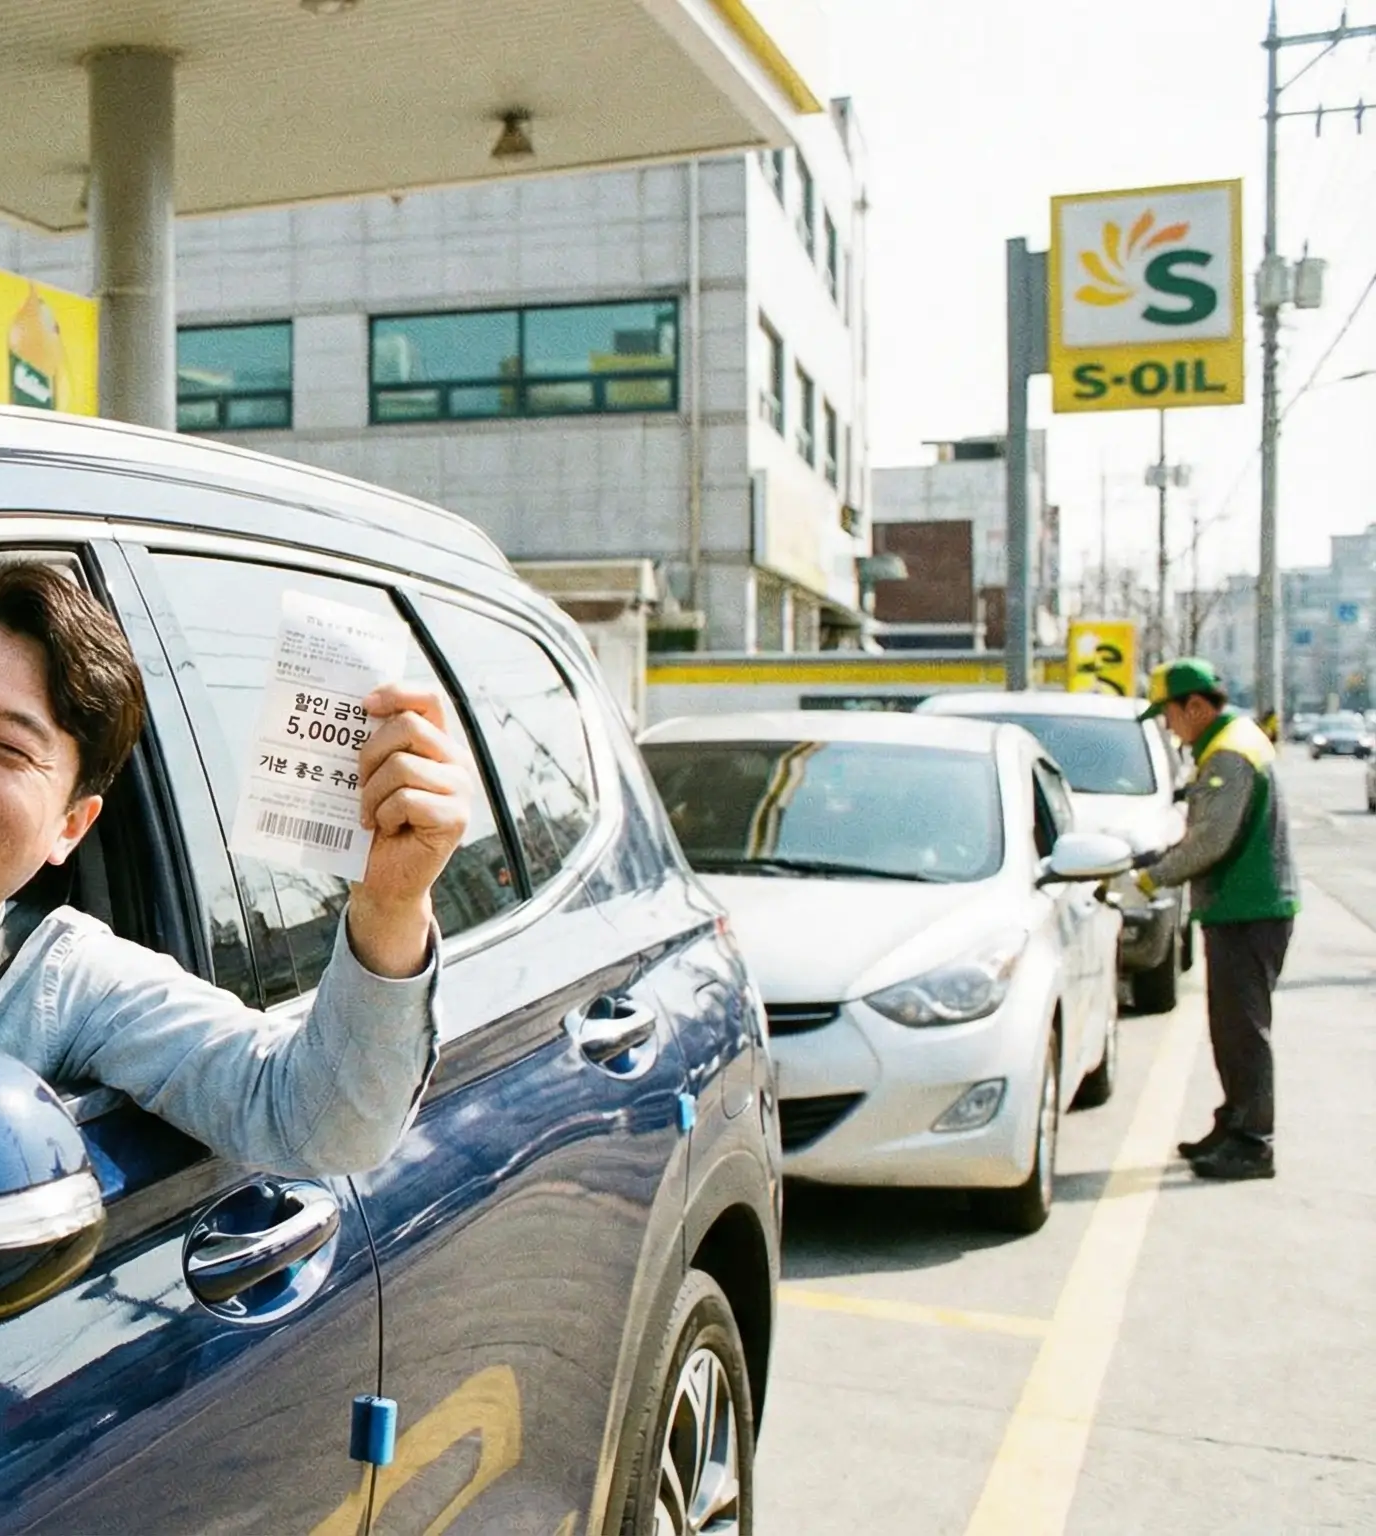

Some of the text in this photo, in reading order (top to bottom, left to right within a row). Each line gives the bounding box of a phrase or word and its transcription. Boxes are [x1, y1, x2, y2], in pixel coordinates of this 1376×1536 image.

[1073, 358, 1227, 400] S-OIL
[295, 692, 329, 716] 할인
[286, 715, 372, 751] 5,000원
[259, 754, 359, 791] 기분 좋은 주유
